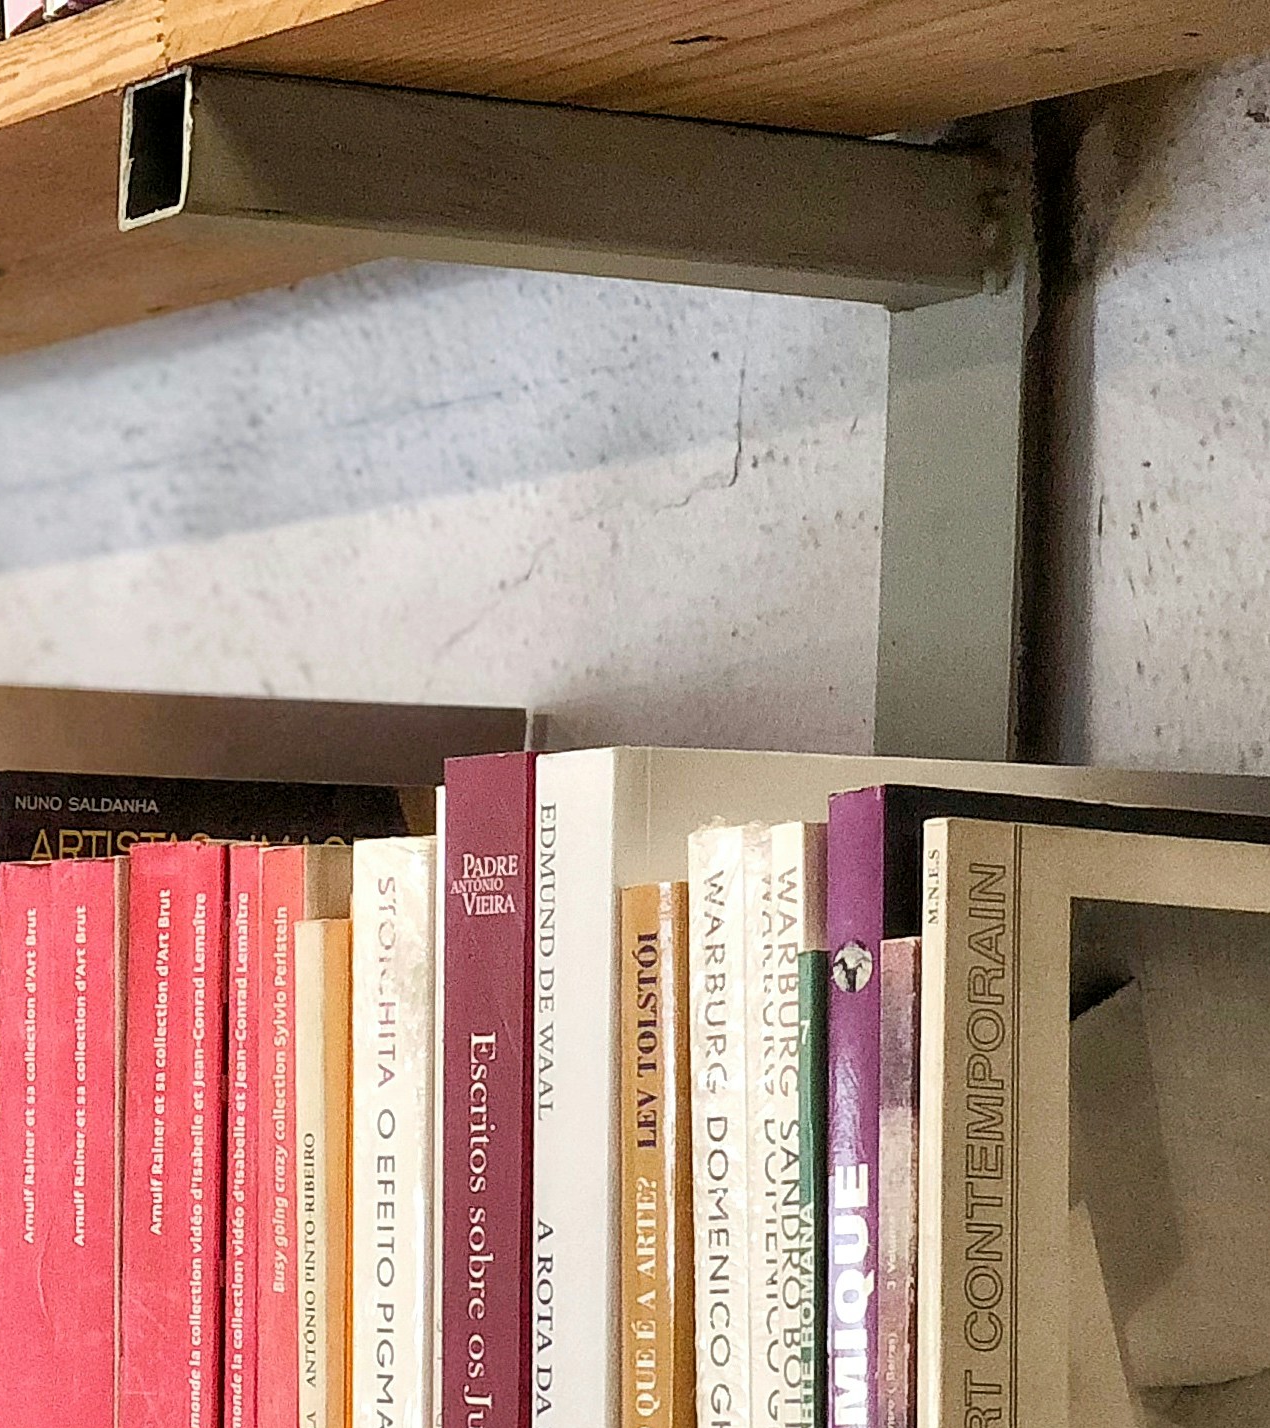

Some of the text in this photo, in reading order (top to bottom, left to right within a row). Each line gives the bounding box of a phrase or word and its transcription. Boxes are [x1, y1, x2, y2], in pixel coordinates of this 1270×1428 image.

[14, 796, 160, 814] NUNO SALDANHA
[450, 876, 504, 894] ANTÓNIO
[462, 853, 519, 879] PADRE
[462, 892, 515, 916] VIEIRA
[927, 848, 940, 925] M.N.E.S
[191, 892, 206, 973] Lemaître
[537, 803, 557, 1121] EDMUND DE WAAL
[704, 869, 728, 1095] WARBURG
[192, 976, 206, 1088] Jean-Conrad
[22, 907, 37, 1244] Arnulf Rainer et sa collection d'Art Brut
[193, 1090, 204, 1111] et
[274, 906, 289, 1294] Busy going crazy collection Sylvio Perlstein
[469, 1031, 497, 1193] Escritos
[776, 865, 801, 1310] WARBURG SANDRO
[961, 861, 1007, 1353] CONTEMPORAIN
[190, 1114, 204, 1200] d'Isabelle
[376, 1107, 396, 1140] O
[635, 1087, 658, 1149] LEV
[189, 1204, 204, 1253] vidéo
[376, 1154, 396, 1288] EFEITO
[536, 1217, 553, 1240] A
[635, 1175, 657, 1280] ARTE?
[705, 1116, 730, 1368] DOMENICO
[189, 1257, 202, 1347] collection
[467, 1206, 494, 1320] sobre
[535, 1254, 553, 1352] ROTA
[635, 1288, 657, 1310] A
[799, 1201, 815, 1349] ROMANA
[189, 1350, 201, 1366] la
[303, 1290, 317, 1389] ANTÓNIO
[466, 1333, 486, 1378] os
[631, 1319, 657, 1340] É
[535, 1364, 552, 1416] DA
[635, 1348, 661, 1417] QUE
